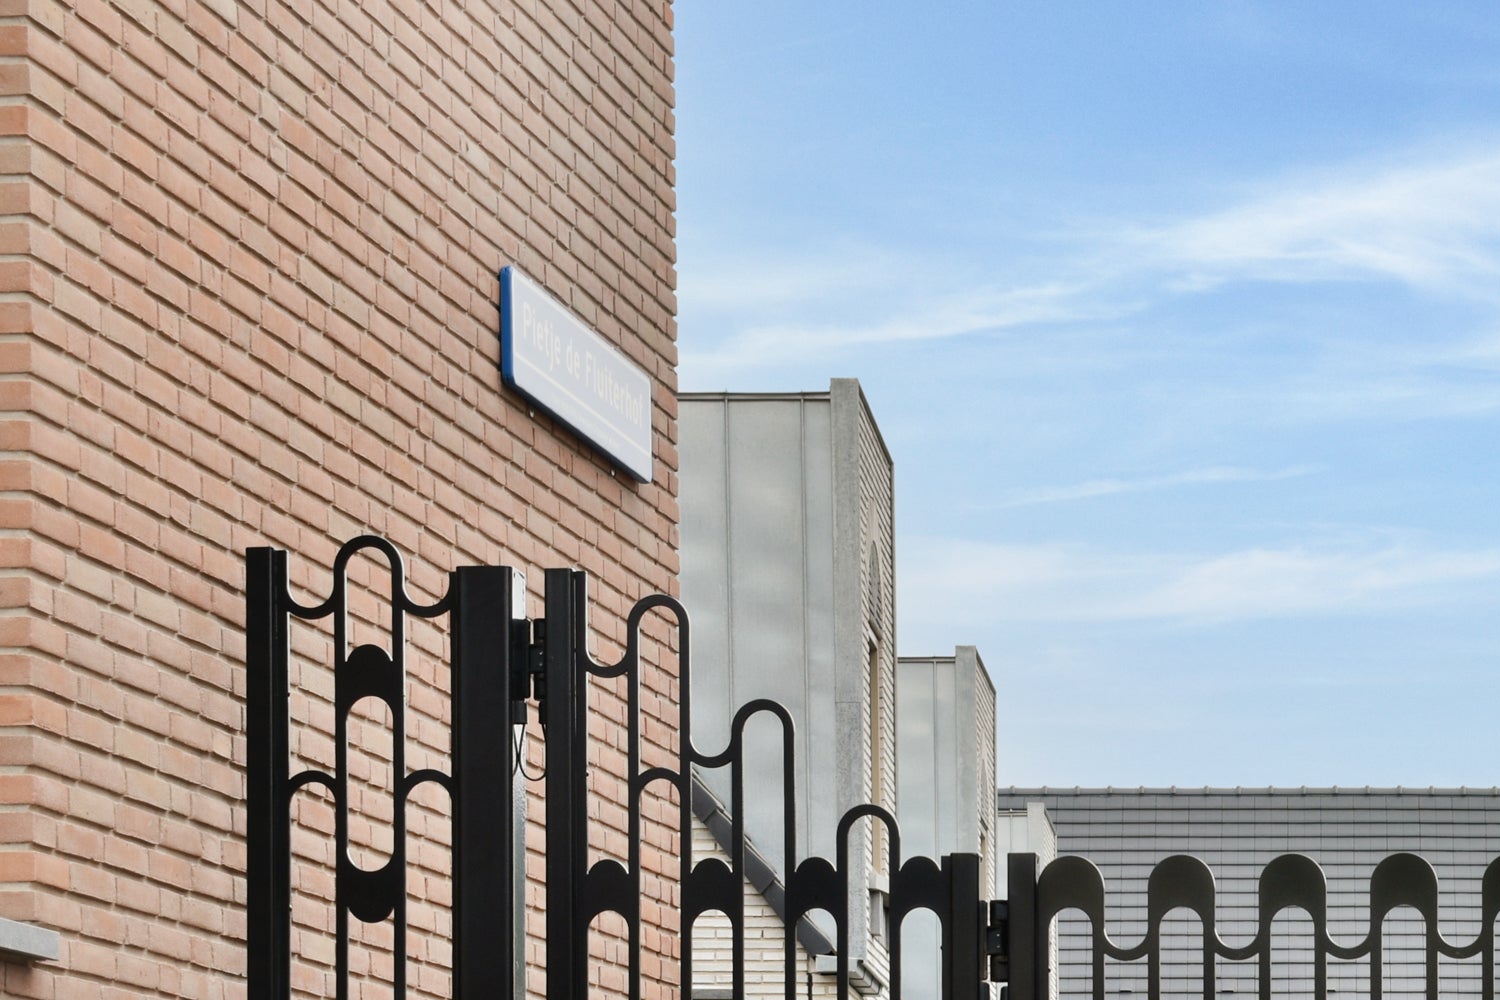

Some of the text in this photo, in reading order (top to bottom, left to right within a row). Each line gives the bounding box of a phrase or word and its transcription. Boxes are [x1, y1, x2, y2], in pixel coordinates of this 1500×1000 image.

[522, 301, 562, 371] Pietje
[565, 339, 581, 380] de
[584, 350, 644, 430] Fluiterhof
